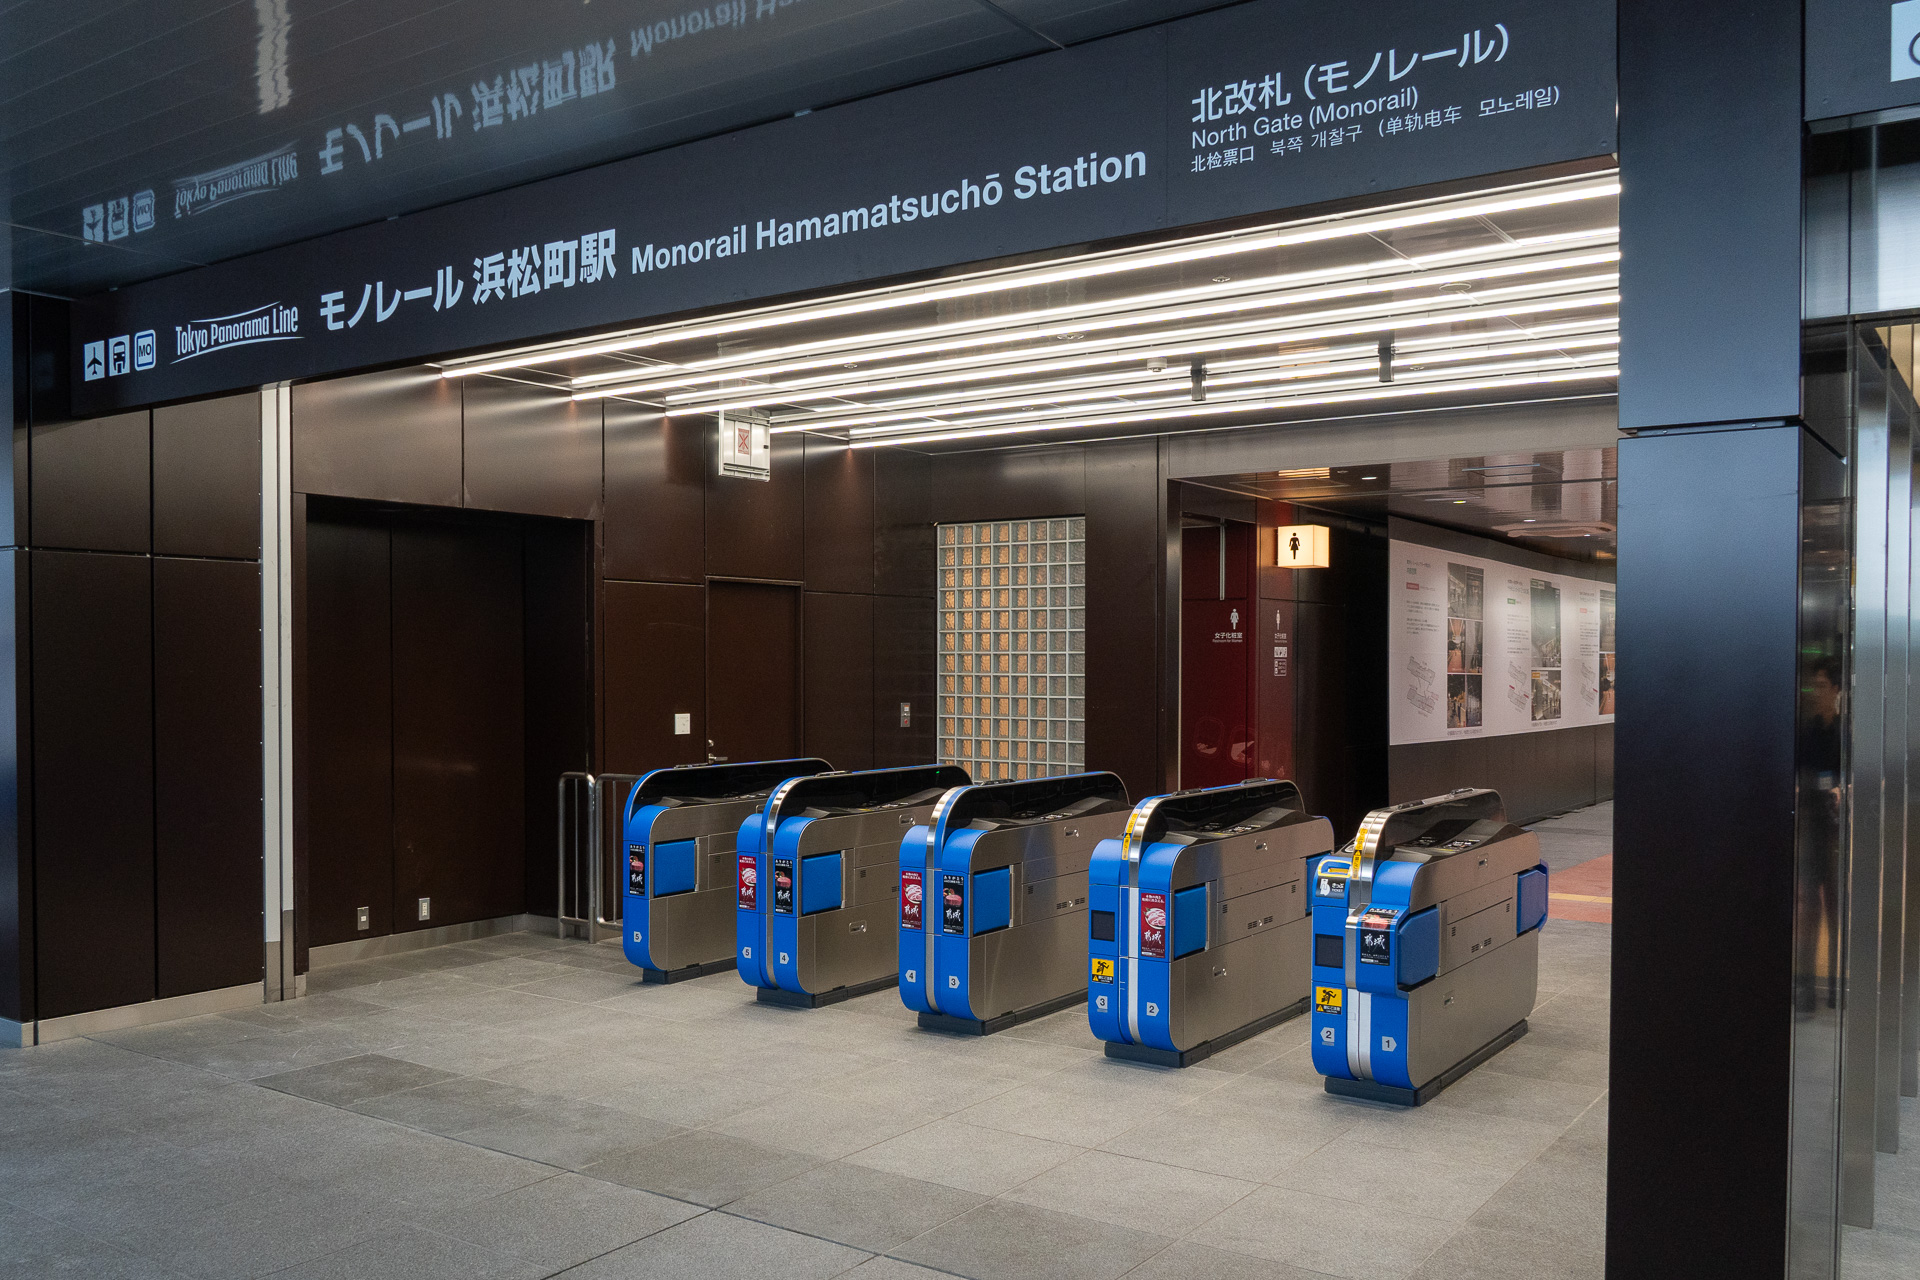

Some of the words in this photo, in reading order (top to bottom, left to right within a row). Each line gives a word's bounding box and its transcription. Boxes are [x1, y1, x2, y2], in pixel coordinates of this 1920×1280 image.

[1192, 73, 1291, 123] 北改札
[1304, 24, 1508, 99] (モノレール)
[1193, 123, 1246, 149] North
[1254, 114, 1303, 136] Gate
[1310, 86, 1418, 130] (Monorail)
[1479, 86, 1560, 117] 모노레일)
[1379, 106, 1462, 138] (单轨电车
[1271, 136, 1303, 157] 북쪽
[1311, 125, 1363, 147] 개찰구
[1191, 146, 1254, 172] 北检票口
[633, 225, 747, 275] Monorail
[757, 173, 981, 250] Hamamatsuchō
[1014, 152, 1146, 199] Station
[320, 266, 464, 331] モノレール
[473, 229, 616, 304] 浜松町駅
[175, 325, 208, 355] Tokyo
[211, 316, 269, 345] Panorama
[273, 306, 299, 334] Line
[138, 344, 152, 357] MO
[1326, 1030, 1332, 1039] 2
